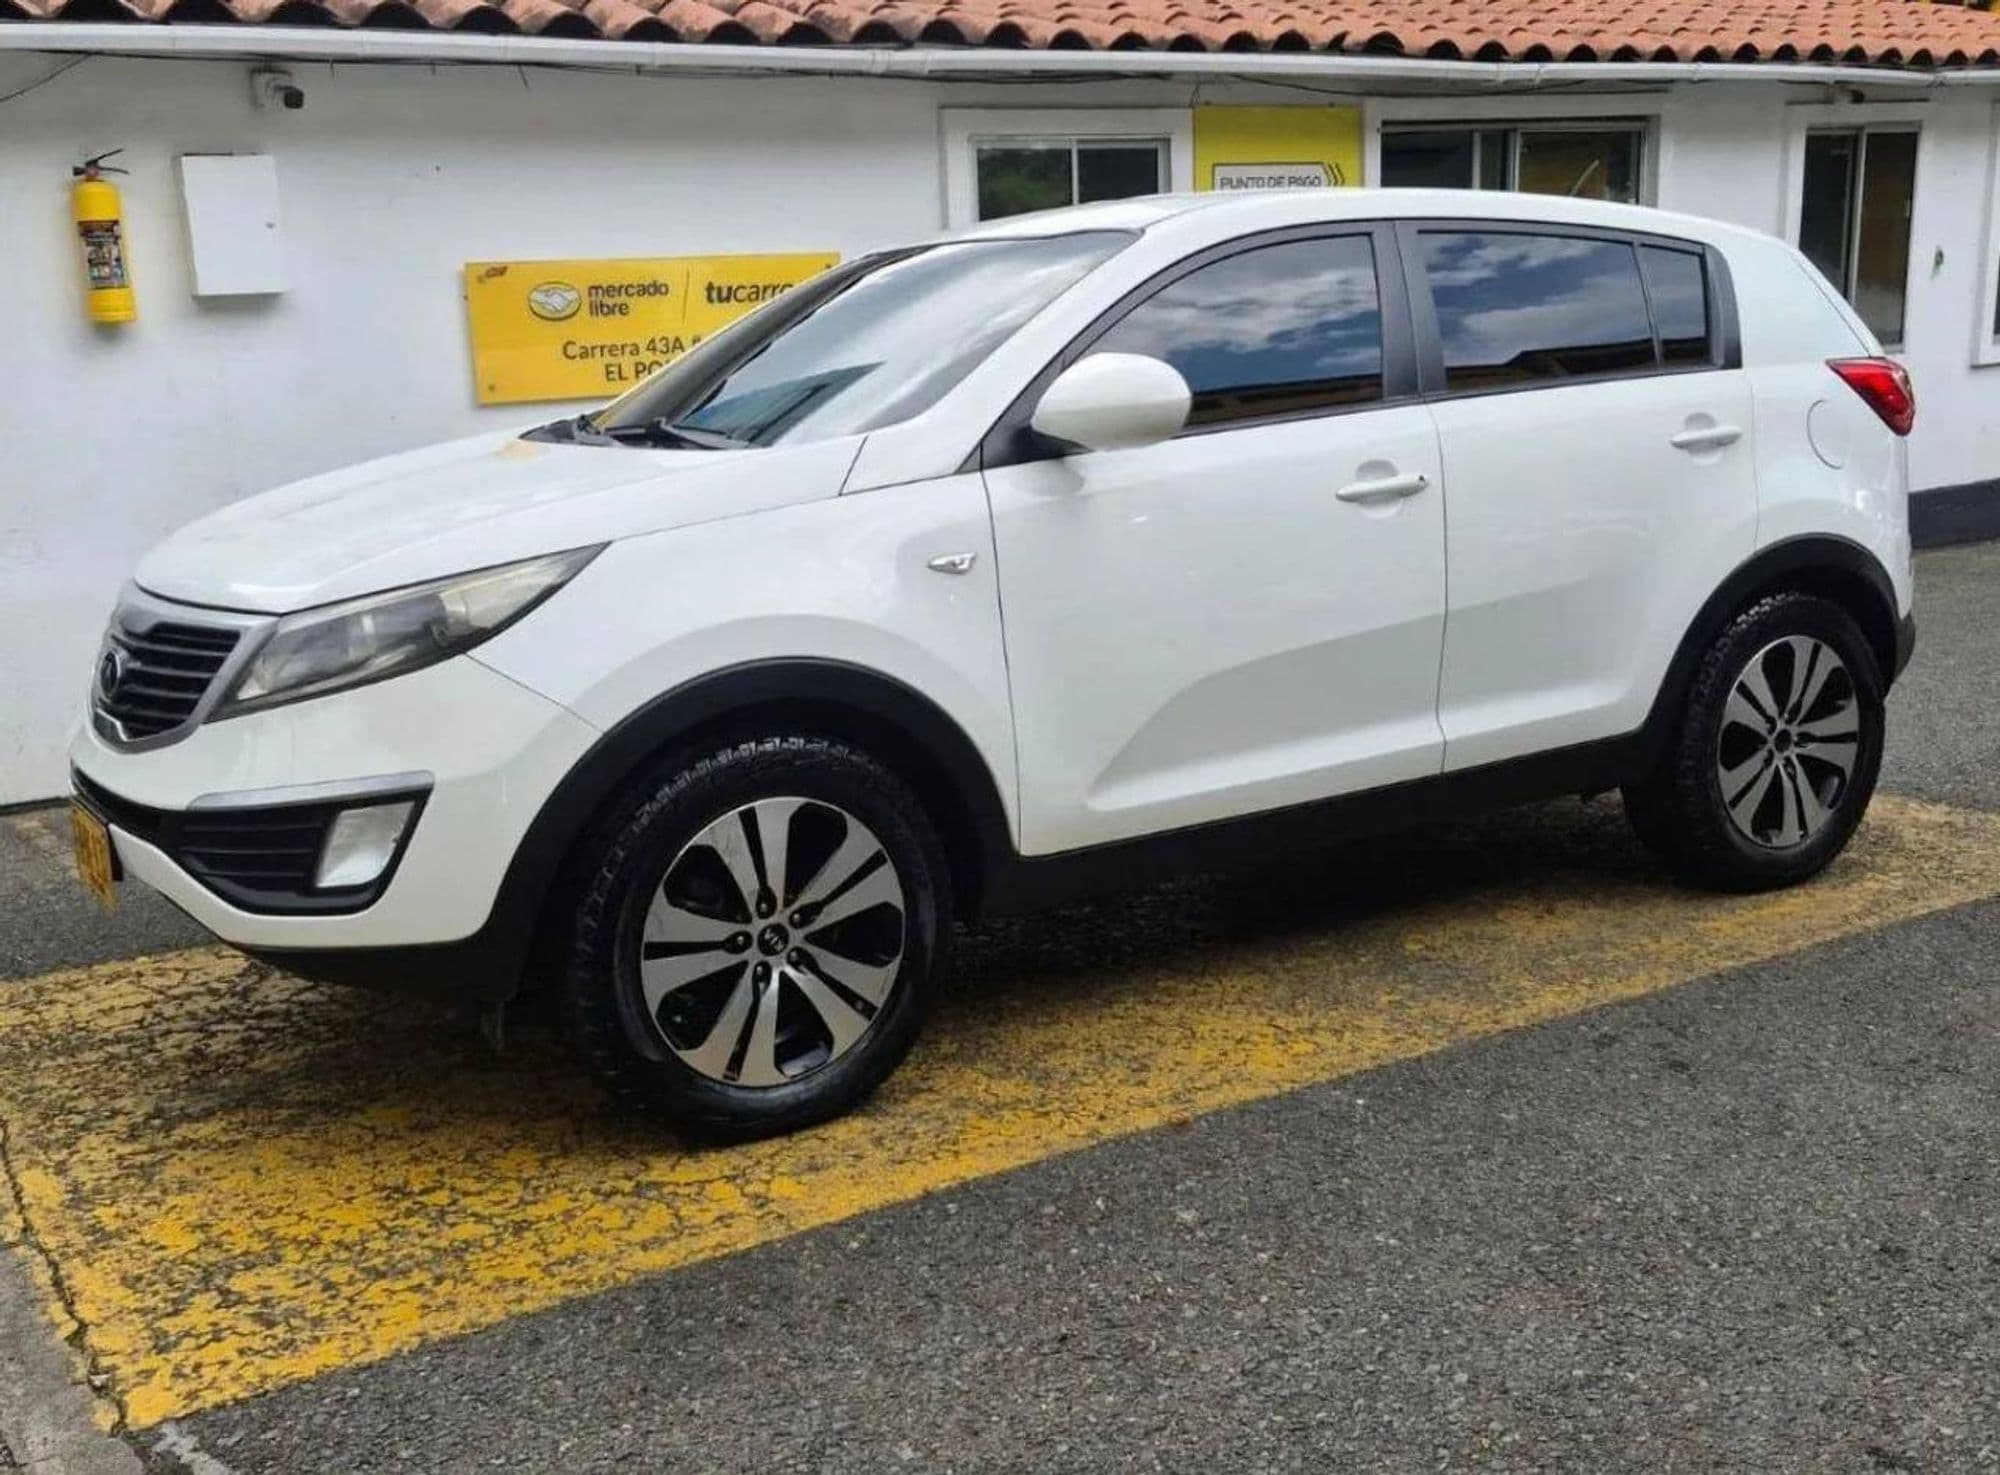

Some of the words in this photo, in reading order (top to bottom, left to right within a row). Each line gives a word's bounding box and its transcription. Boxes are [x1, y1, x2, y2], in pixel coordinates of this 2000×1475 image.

[1220, 176, 1265, 190] PUNTO
[1266, 176, 1285, 189] DE
[1287, 176, 1322, 188] PAGO
[588, 280, 669, 298] mercado
[589, 300, 630, 317] libre
[562, 340, 640, 360] Carrera
[645, 335, 685, 354] 43A
[605, 363, 629, 382] EL
